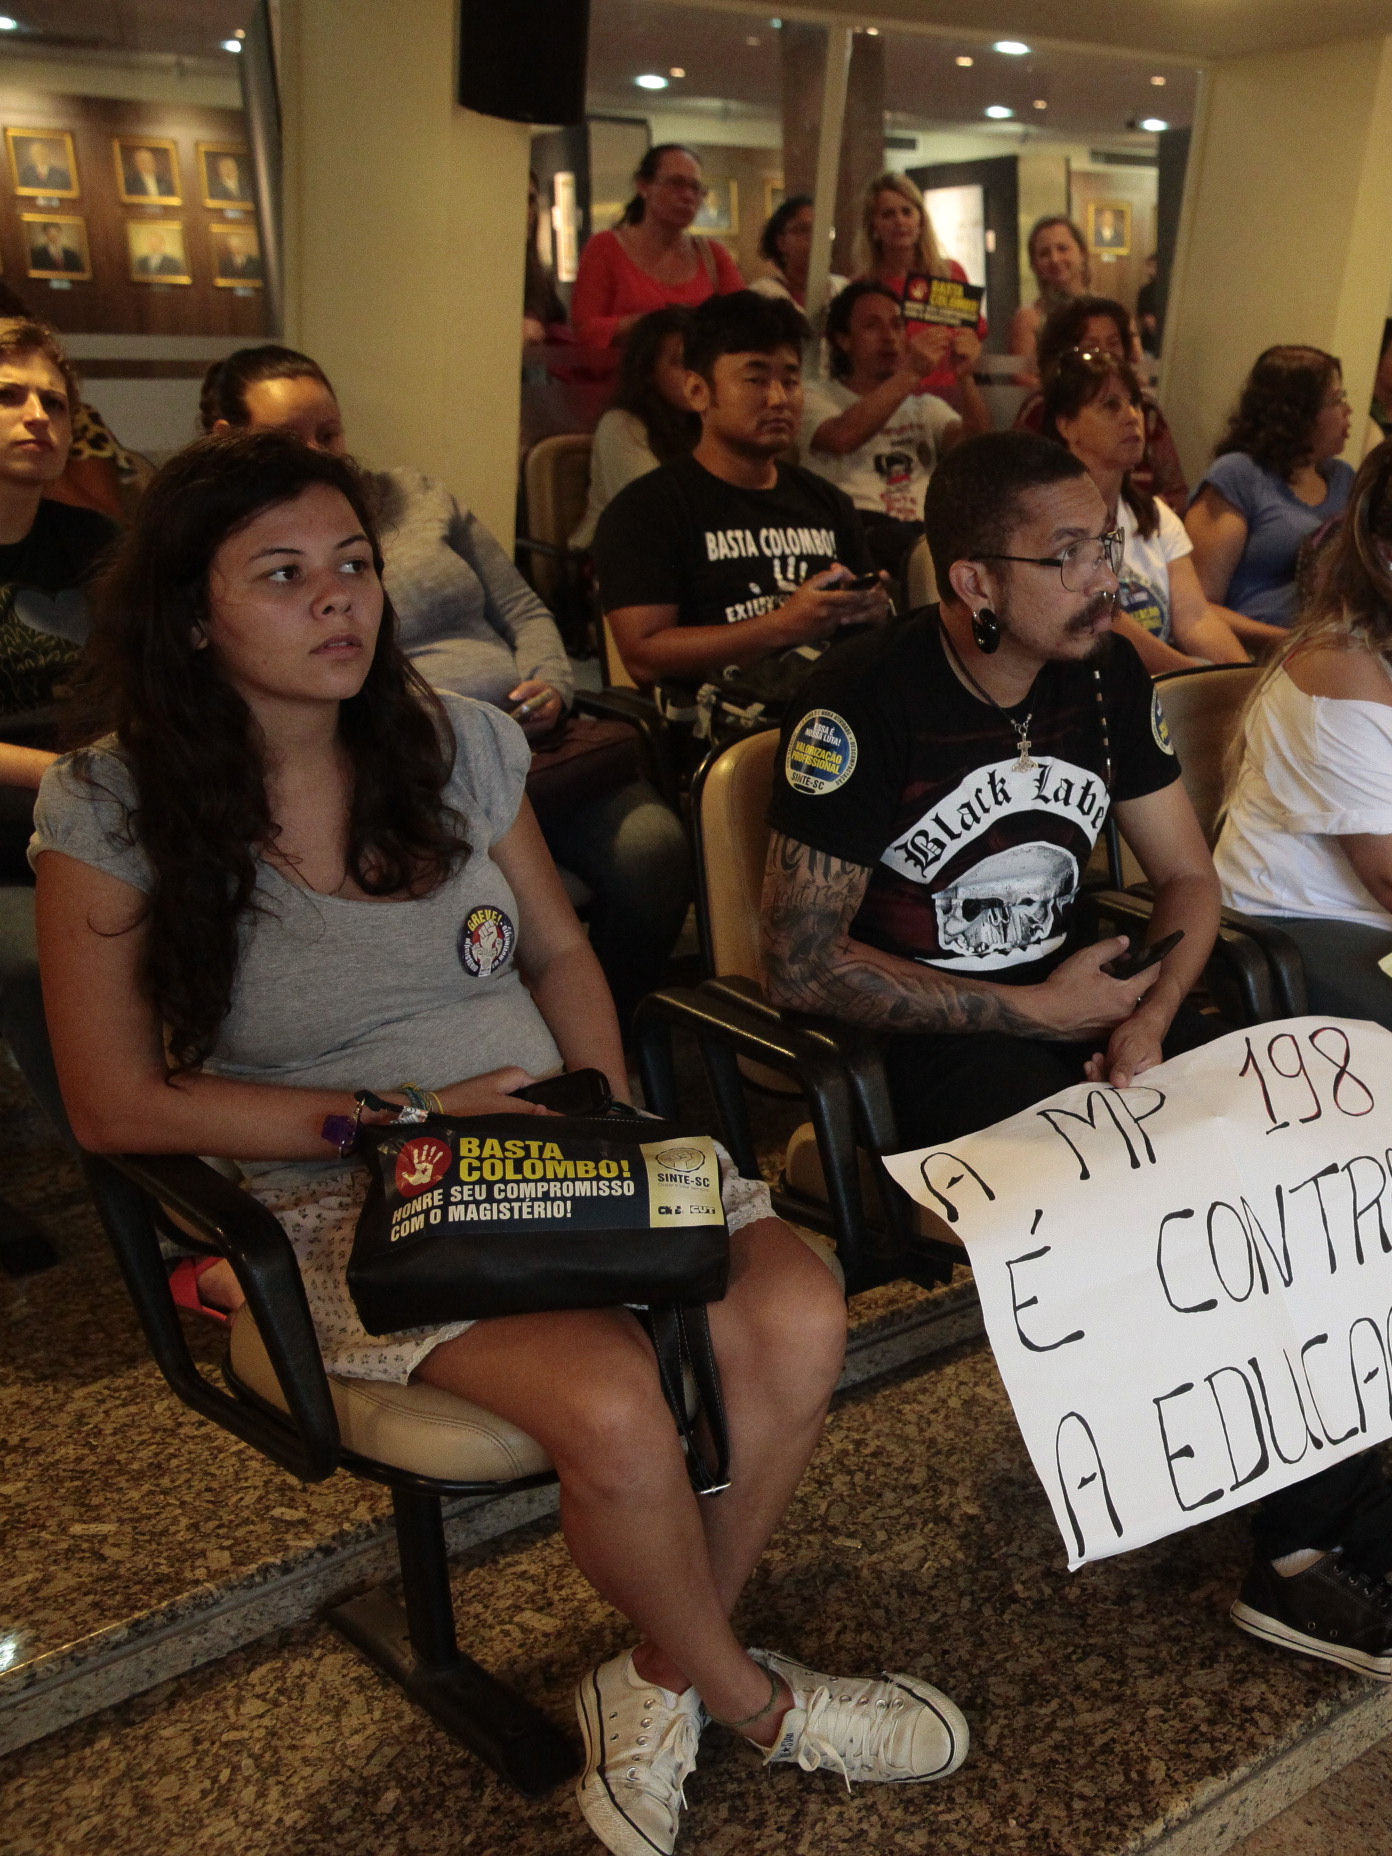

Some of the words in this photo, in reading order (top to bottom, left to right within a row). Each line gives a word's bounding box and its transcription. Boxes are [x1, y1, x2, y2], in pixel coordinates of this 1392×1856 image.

[704, 529, 759, 561] BASTA
[759, 527, 837, 559] COLOMBO!
[823, 735, 842, 747] LUTA!
[829, 727, 836, 736] É
[791, 750, 840, 775] PROFISSIONAL
[795, 741, 843, 764] VALORIZAÇÃO
[791, 772, 825, 790] SINTE-SC
[894, 769, 1012, 879] Black
[1031, 764, 1107, 829] Labe
[467, 909, 503, 932] GREVE!
[920, 1152, 995, 1222] A
[1036, 1086, 1166, 1180] MP
[1239, 1027, 1374, 1135] 198
[459, 1137, 564, 1160] BASTA
[459, 1158, 631, 1182] COLOMBO!
[657, 1173, 710, 1187] SINTE-SC
[392, 1189, 444, 1223] HONRE
[450, 1185, 487, 1205] SEU
[493, 1181, 635, 1200] COMPROMISSO
[390, 1216, 425, 1242] COM
[430, 1209, 442, 1225] O
[448, 1199, 572, 1222] MAGISTÉRIO!
[1005, 1209, 1085, 1352] É
[1055, 1411, 1124, 1558] A
